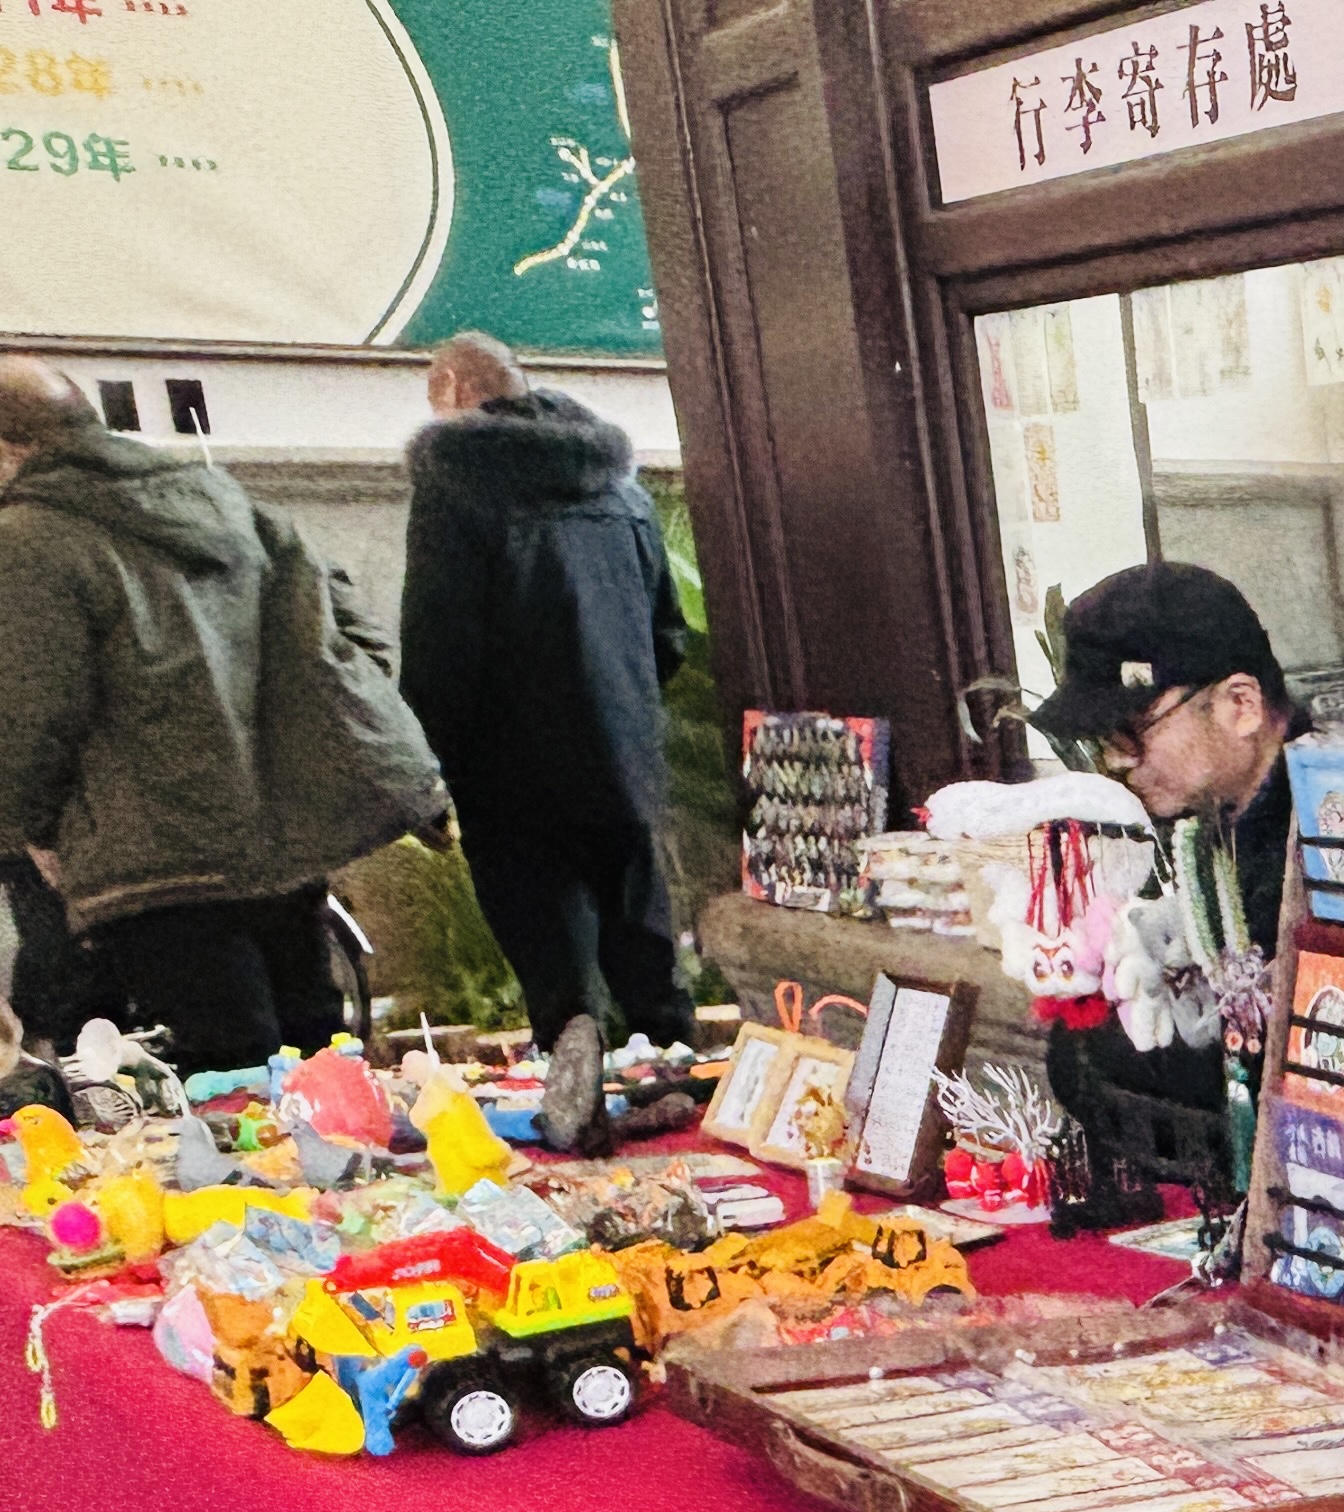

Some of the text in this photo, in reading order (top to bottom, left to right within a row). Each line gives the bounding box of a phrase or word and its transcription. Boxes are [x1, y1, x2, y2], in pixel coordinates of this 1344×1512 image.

[1009, 1, 1298, 171] 行李寄存處
[0, 127, 136, 183] 29年
